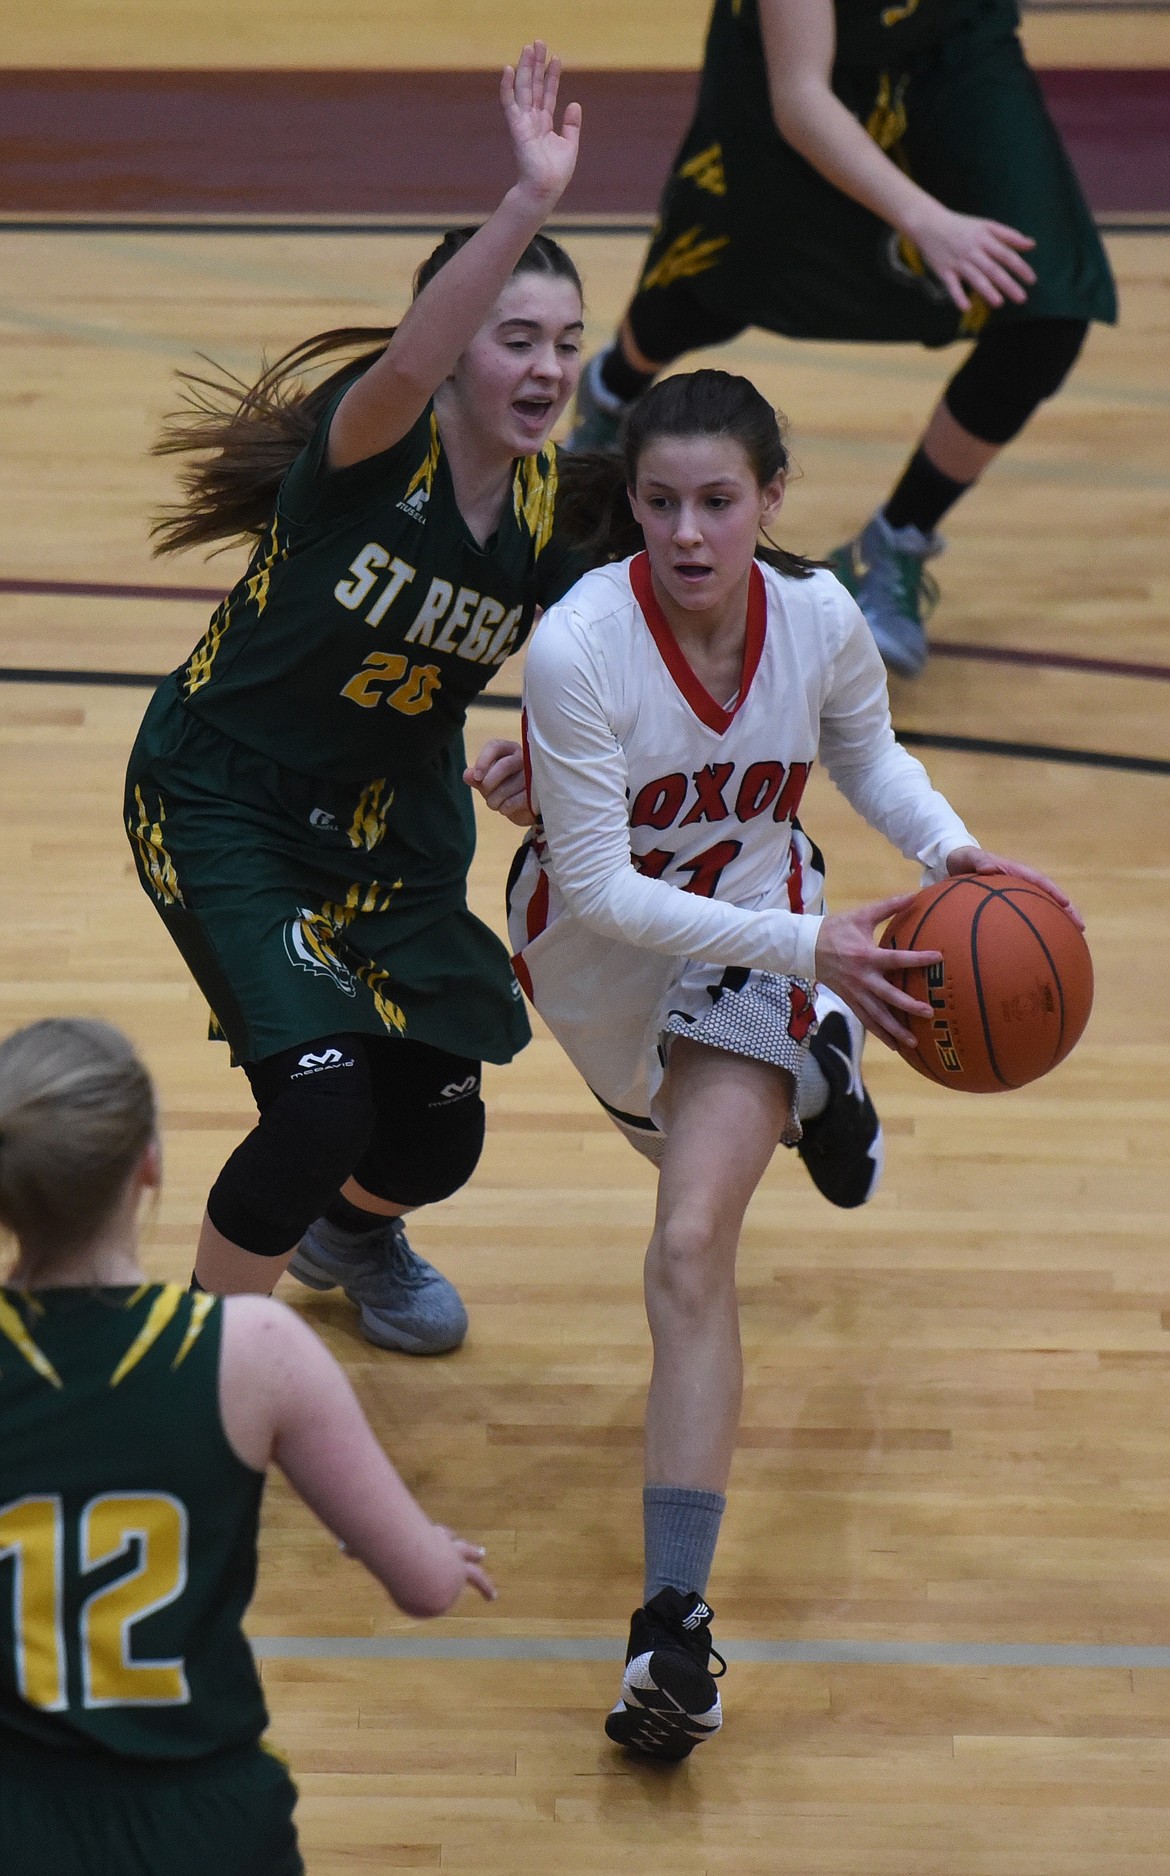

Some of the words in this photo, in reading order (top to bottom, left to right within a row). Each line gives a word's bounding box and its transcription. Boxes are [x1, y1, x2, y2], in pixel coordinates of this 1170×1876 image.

[334, 542, 416, 628] ST
[340, 651, 441, 715] 20
[626, 760, 813, 830] OXON
[926, 960, 964, 1072] ELITE
[0, 1492, 191, 1711] 12
